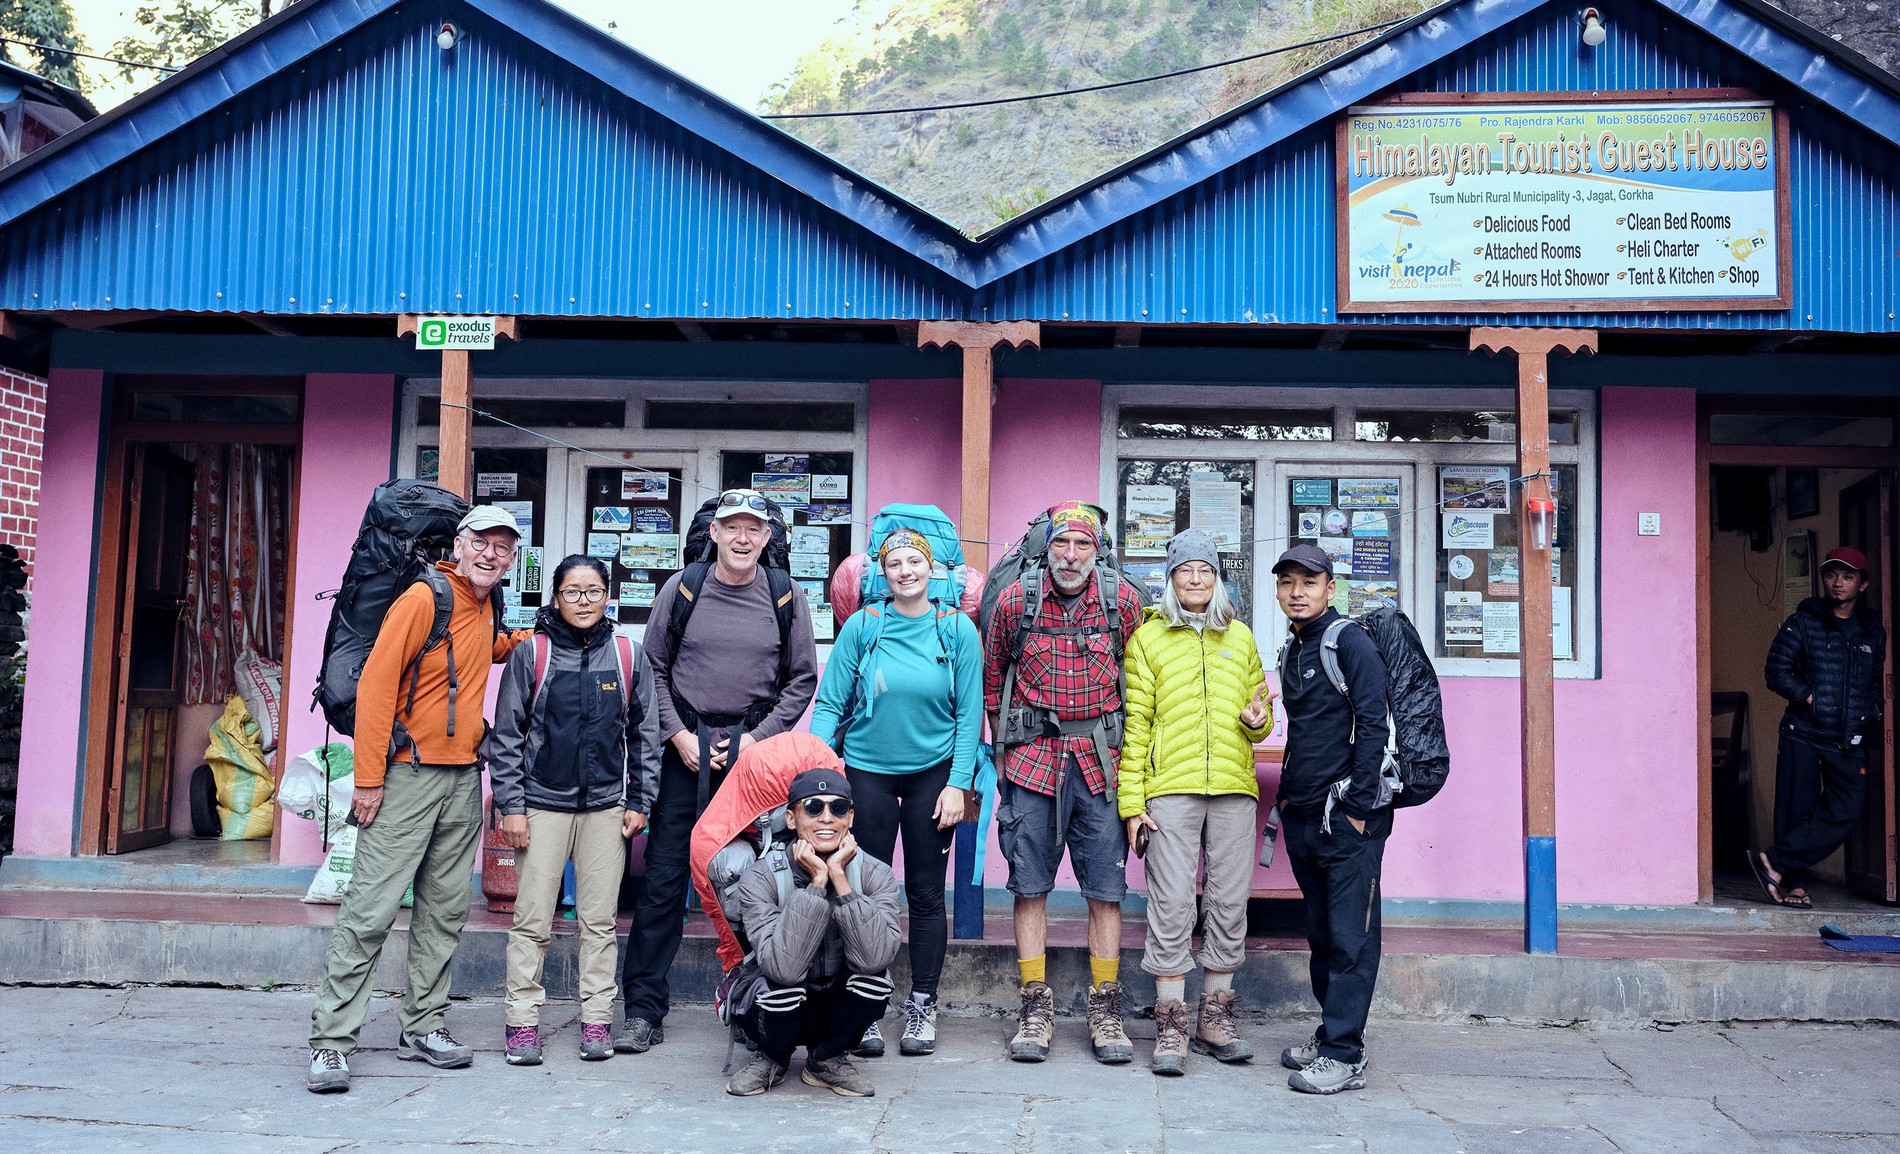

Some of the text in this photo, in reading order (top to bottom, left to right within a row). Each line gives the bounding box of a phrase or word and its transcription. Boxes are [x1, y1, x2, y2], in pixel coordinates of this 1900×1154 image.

[1480, 117, 1501, 127] Pro.
[1504, 115, 1553, 128] Rajendra
[1556, 114, 1585, 126] Karki
[1596, 115, 1623, 125] Mob:
[1699, 111, 1766, 123] 9746052067
[1354, 128, 1768, 186] Himalayan Tourist Guest House
[1429, 192, 1455, 204] Tsum
[1457, 191, 1483, 204] Nubri
[1485, 191, 1510, 203] Rural
[1513, 190, 1570, 205] Municipality
[1586, 189, 1616, 204] Jagat,
[1618, 188, 1654, 201] Gorkha
[1484, 214, 1571, 233] Delicious Food
[1627, 212, 1731, 230] Clean Bed Rooms
[1484, 241, 1581, 260] Attached Rooms
[1627, 239, 1700, 258] Heli Charter
[1359, 258, 1455, 282] visit nepal
[1485, 268, 1610, 288] 24 Hours Hot Showor
[1628, 267, 1715, 285] Tent & Kitchen
[1729, 265, 1760, 287] Shop
[1389, 278, 1419, 289] 2020
[448, 320, 491, 332] exodus
[447, 332, 490, 343] travels
[1222, 559, 1243, 569] TREKS
[267, 702, 280, 739] BRAND
